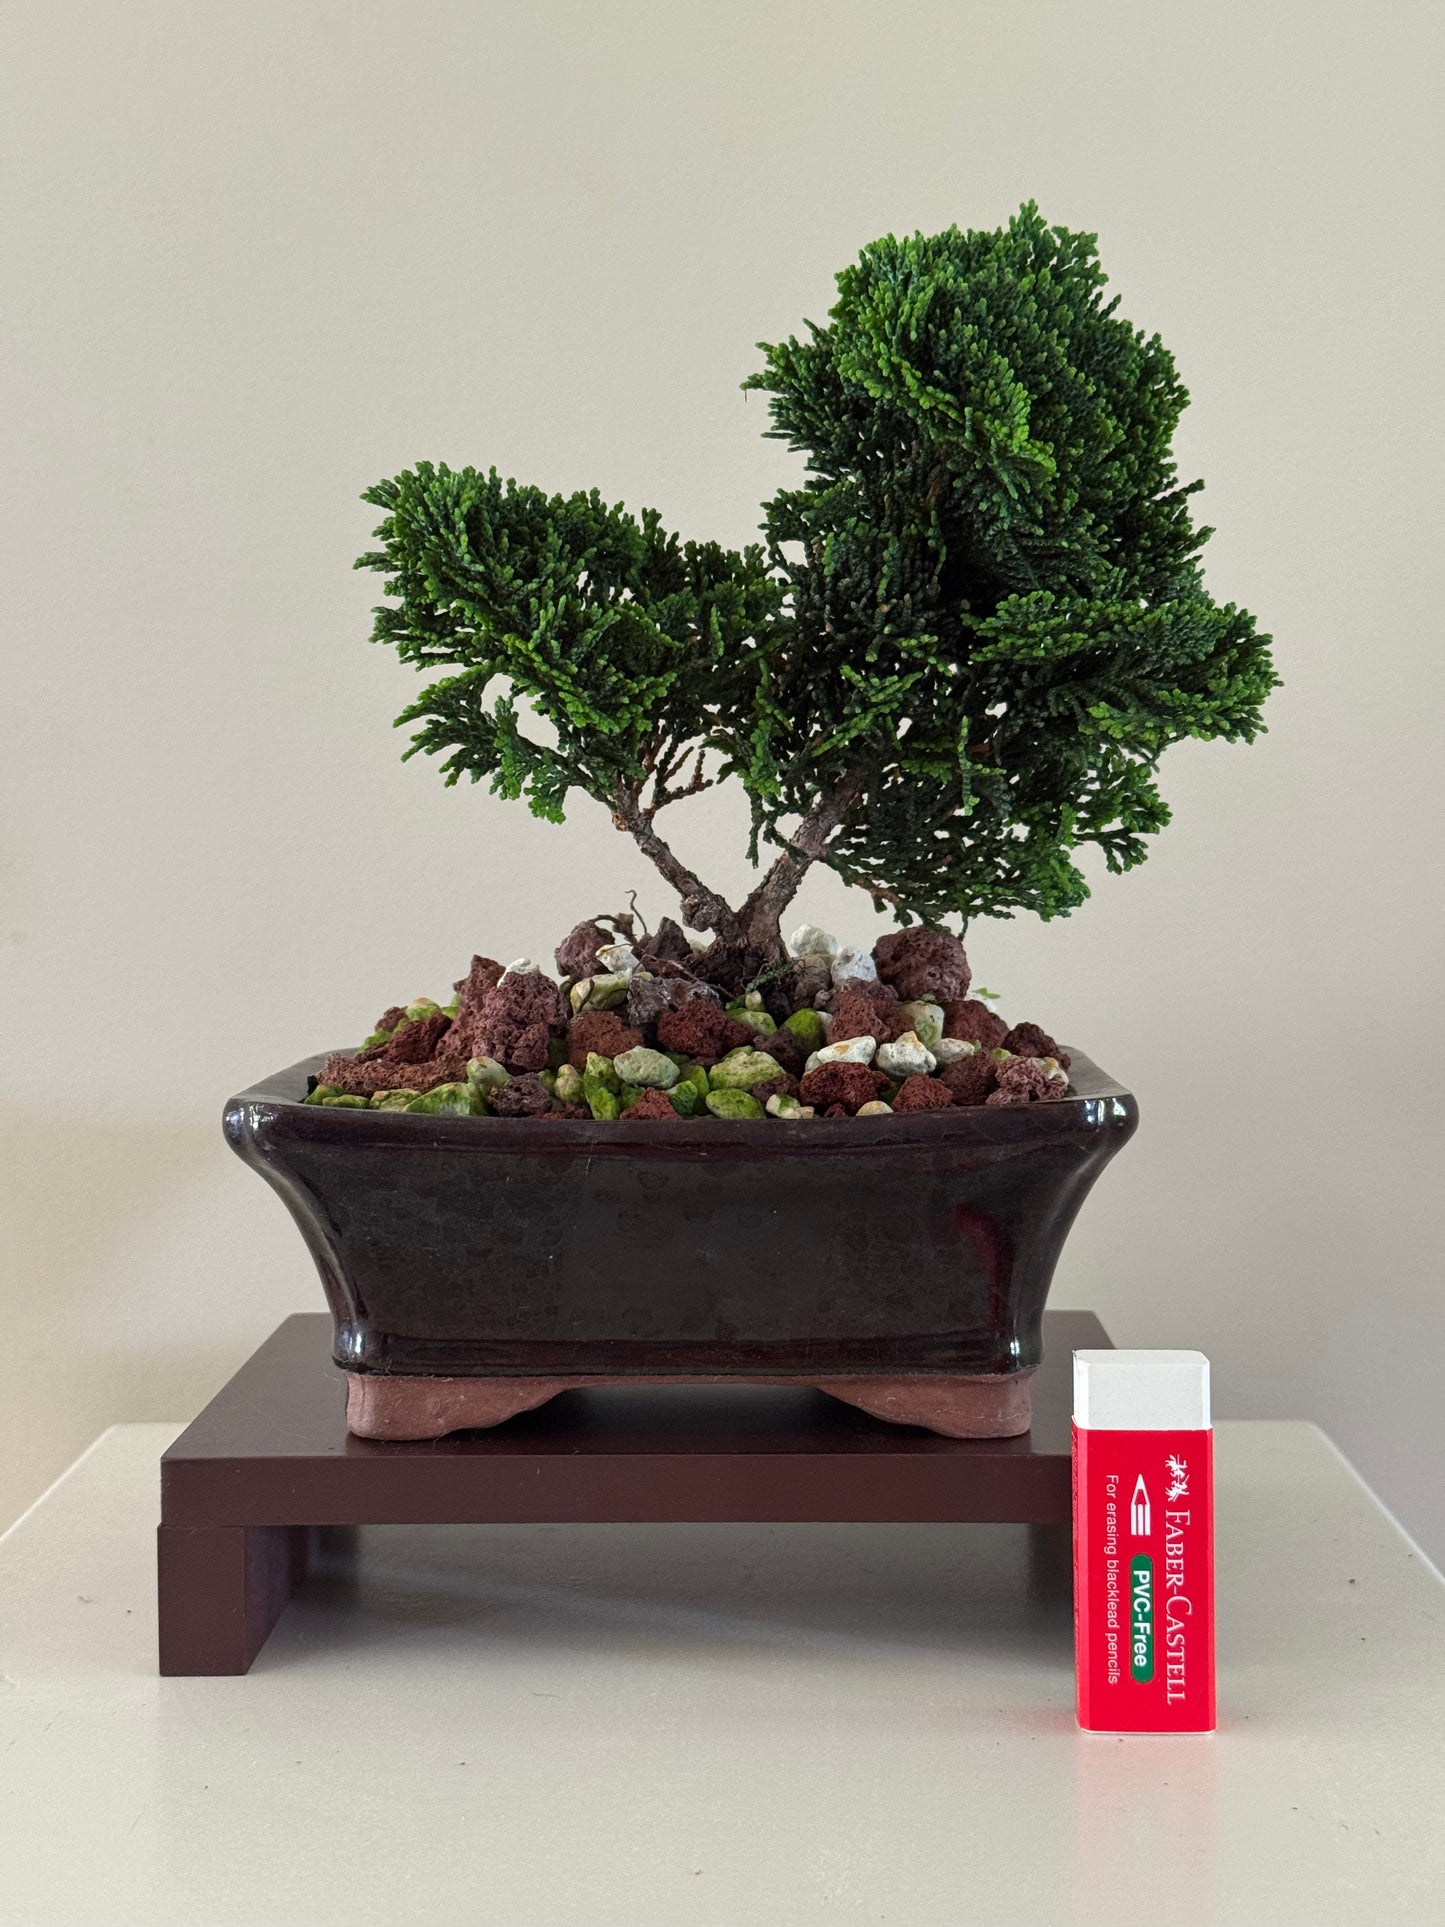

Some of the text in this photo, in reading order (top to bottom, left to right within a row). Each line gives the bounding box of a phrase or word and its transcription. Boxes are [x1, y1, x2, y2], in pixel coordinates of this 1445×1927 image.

[1103, 1474, 1121, 1685] For erasing blacklead pencils
[1133, 1570, 1151, 1667] PVC-Free
[1165, 1510, 1192, 1705] FABER-CASTELL
